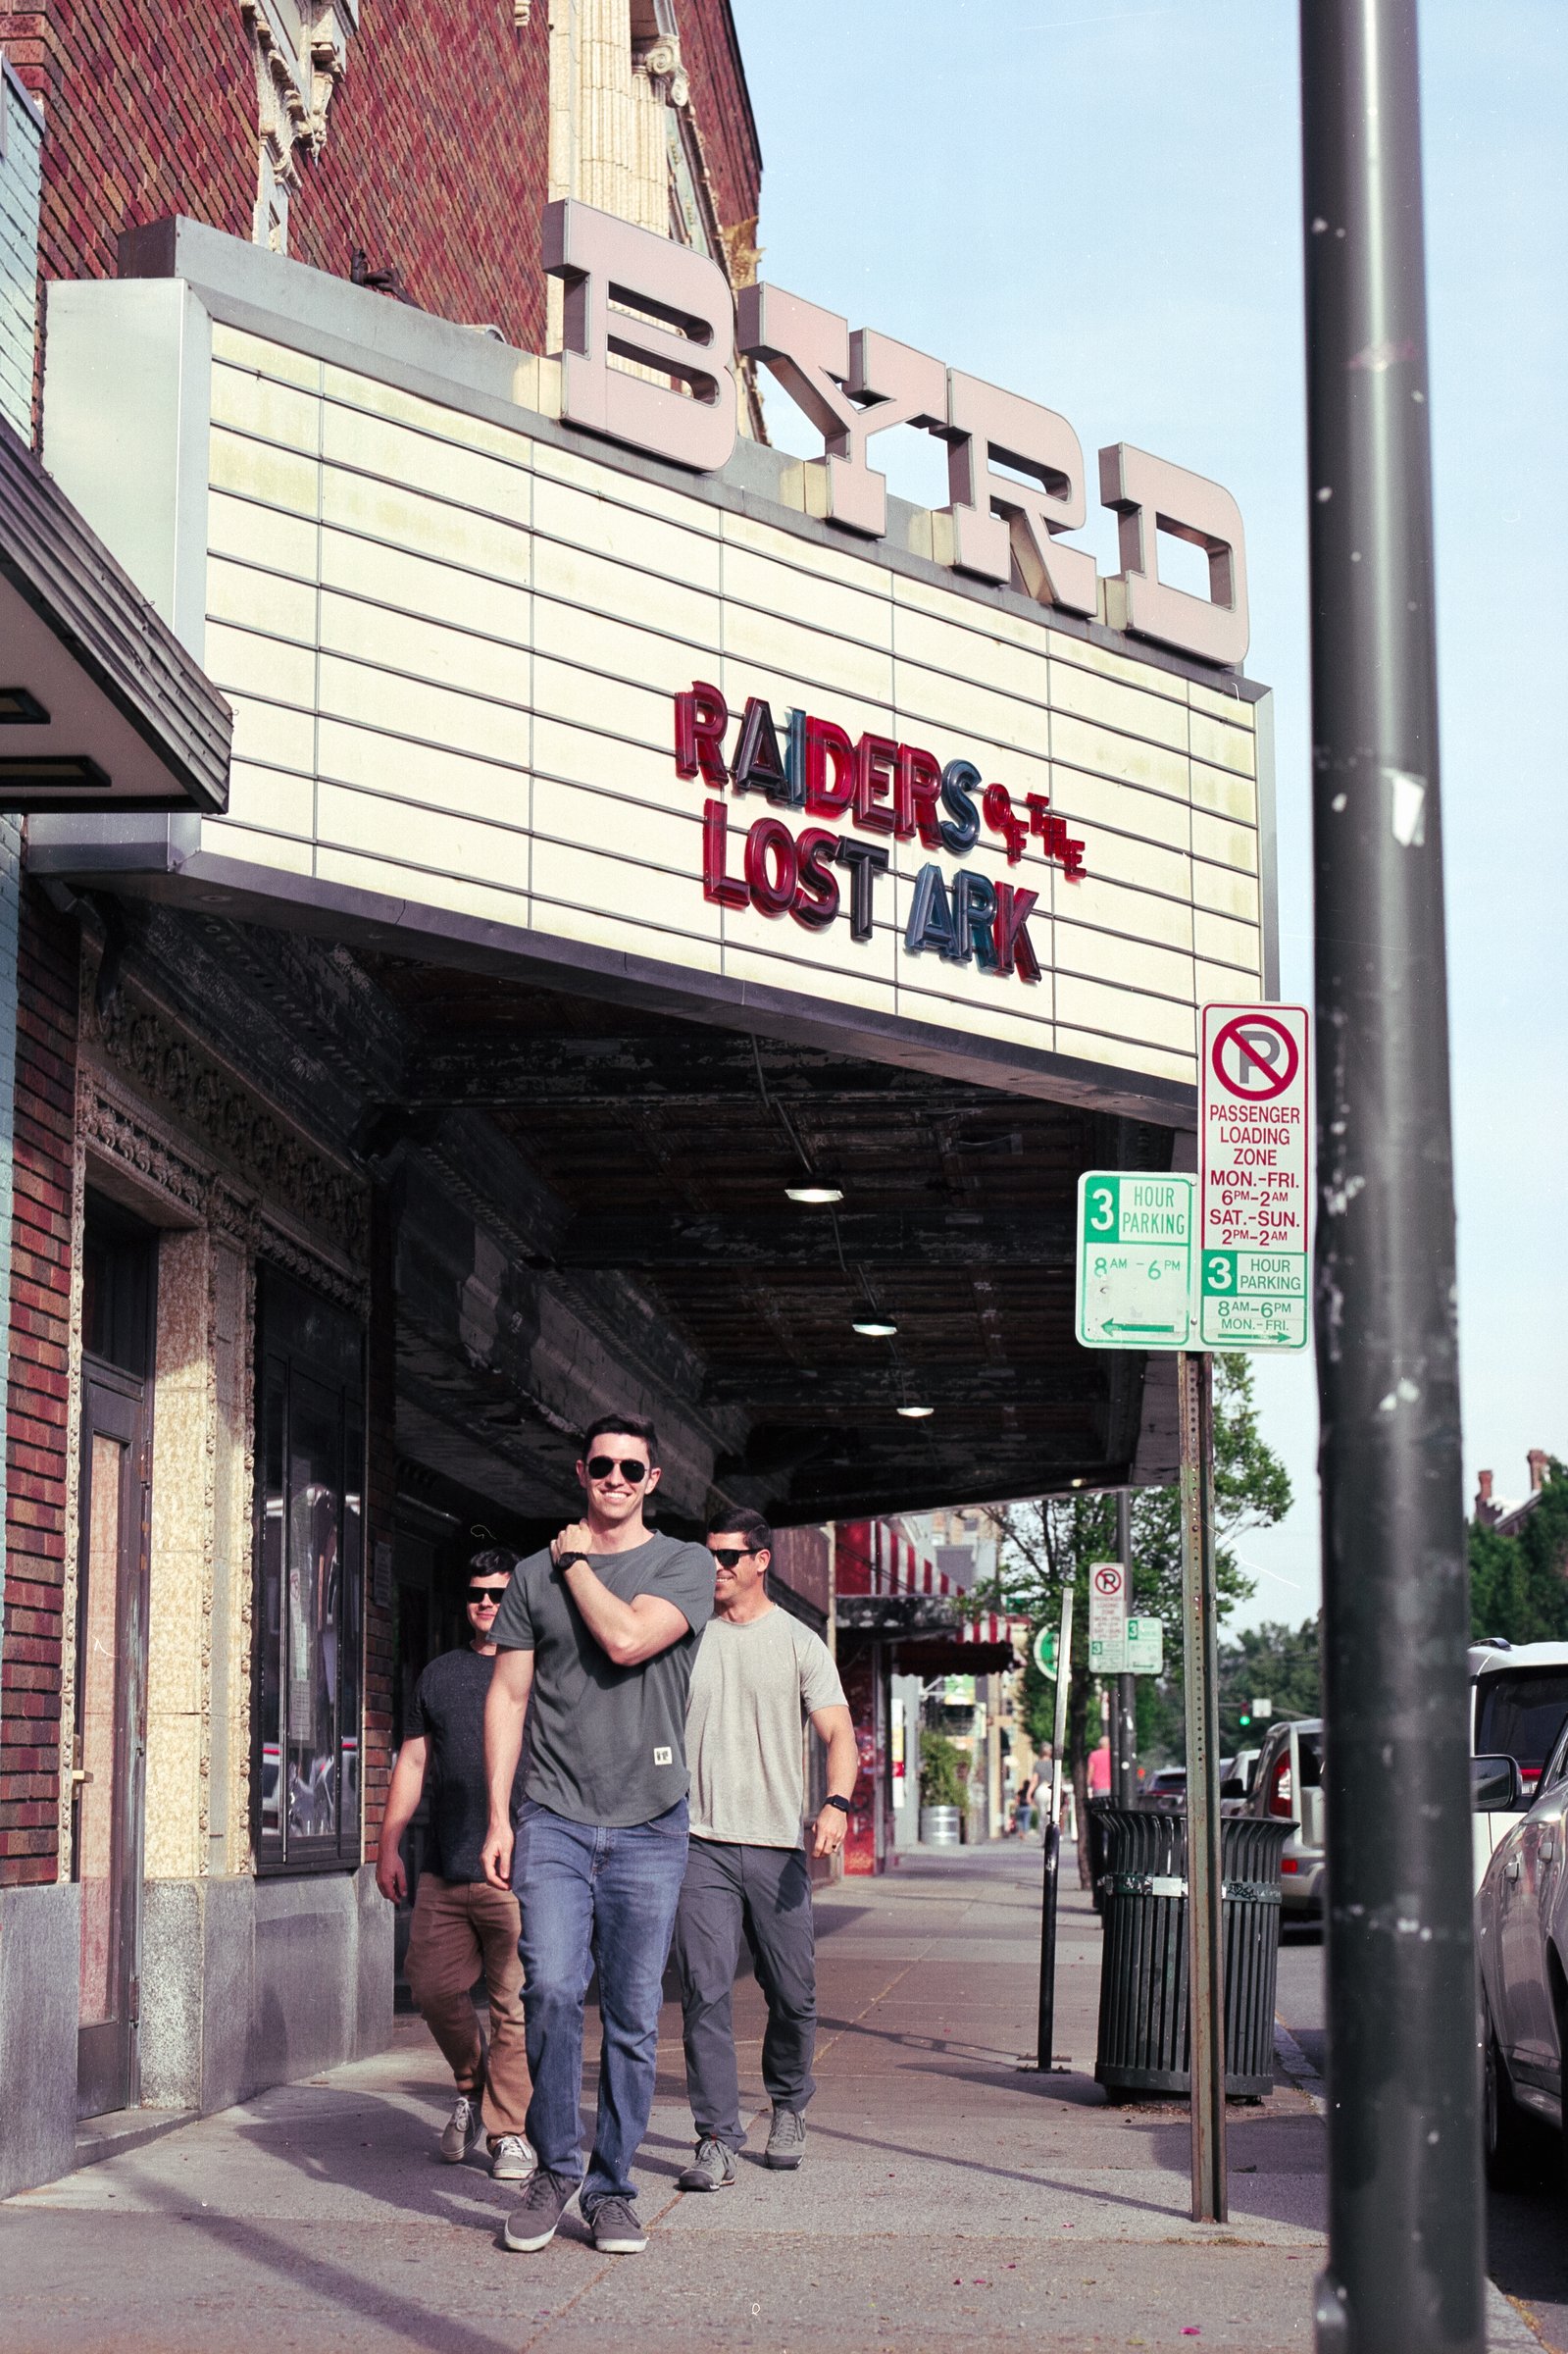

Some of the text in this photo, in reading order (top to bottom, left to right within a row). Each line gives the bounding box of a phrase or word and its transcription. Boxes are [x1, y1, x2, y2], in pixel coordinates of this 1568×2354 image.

[542, 198, 1250, 667] BYRD
[674, 680, 1087, 880] RAIDERS OF THE
[702, 797, 1042, 982] LOST ARK
[1209, 1103, 1300, 1124] PASSENGER
[1220, 1125, 1290, 1146] LOADING
[1233, 1148, 1278, 1166] ZONE
[1134, 1185, 1175, 1207] HOUR
[1089, 1187, 1115, 1232] 3
[1122, 1211, 1185, 1235] PARKING
[1207, 1256, 1233, 1291] 3
[1250, 1257, 1290, 1273] HOUR
[1239, 1274, 1301, 1291] PARKING
